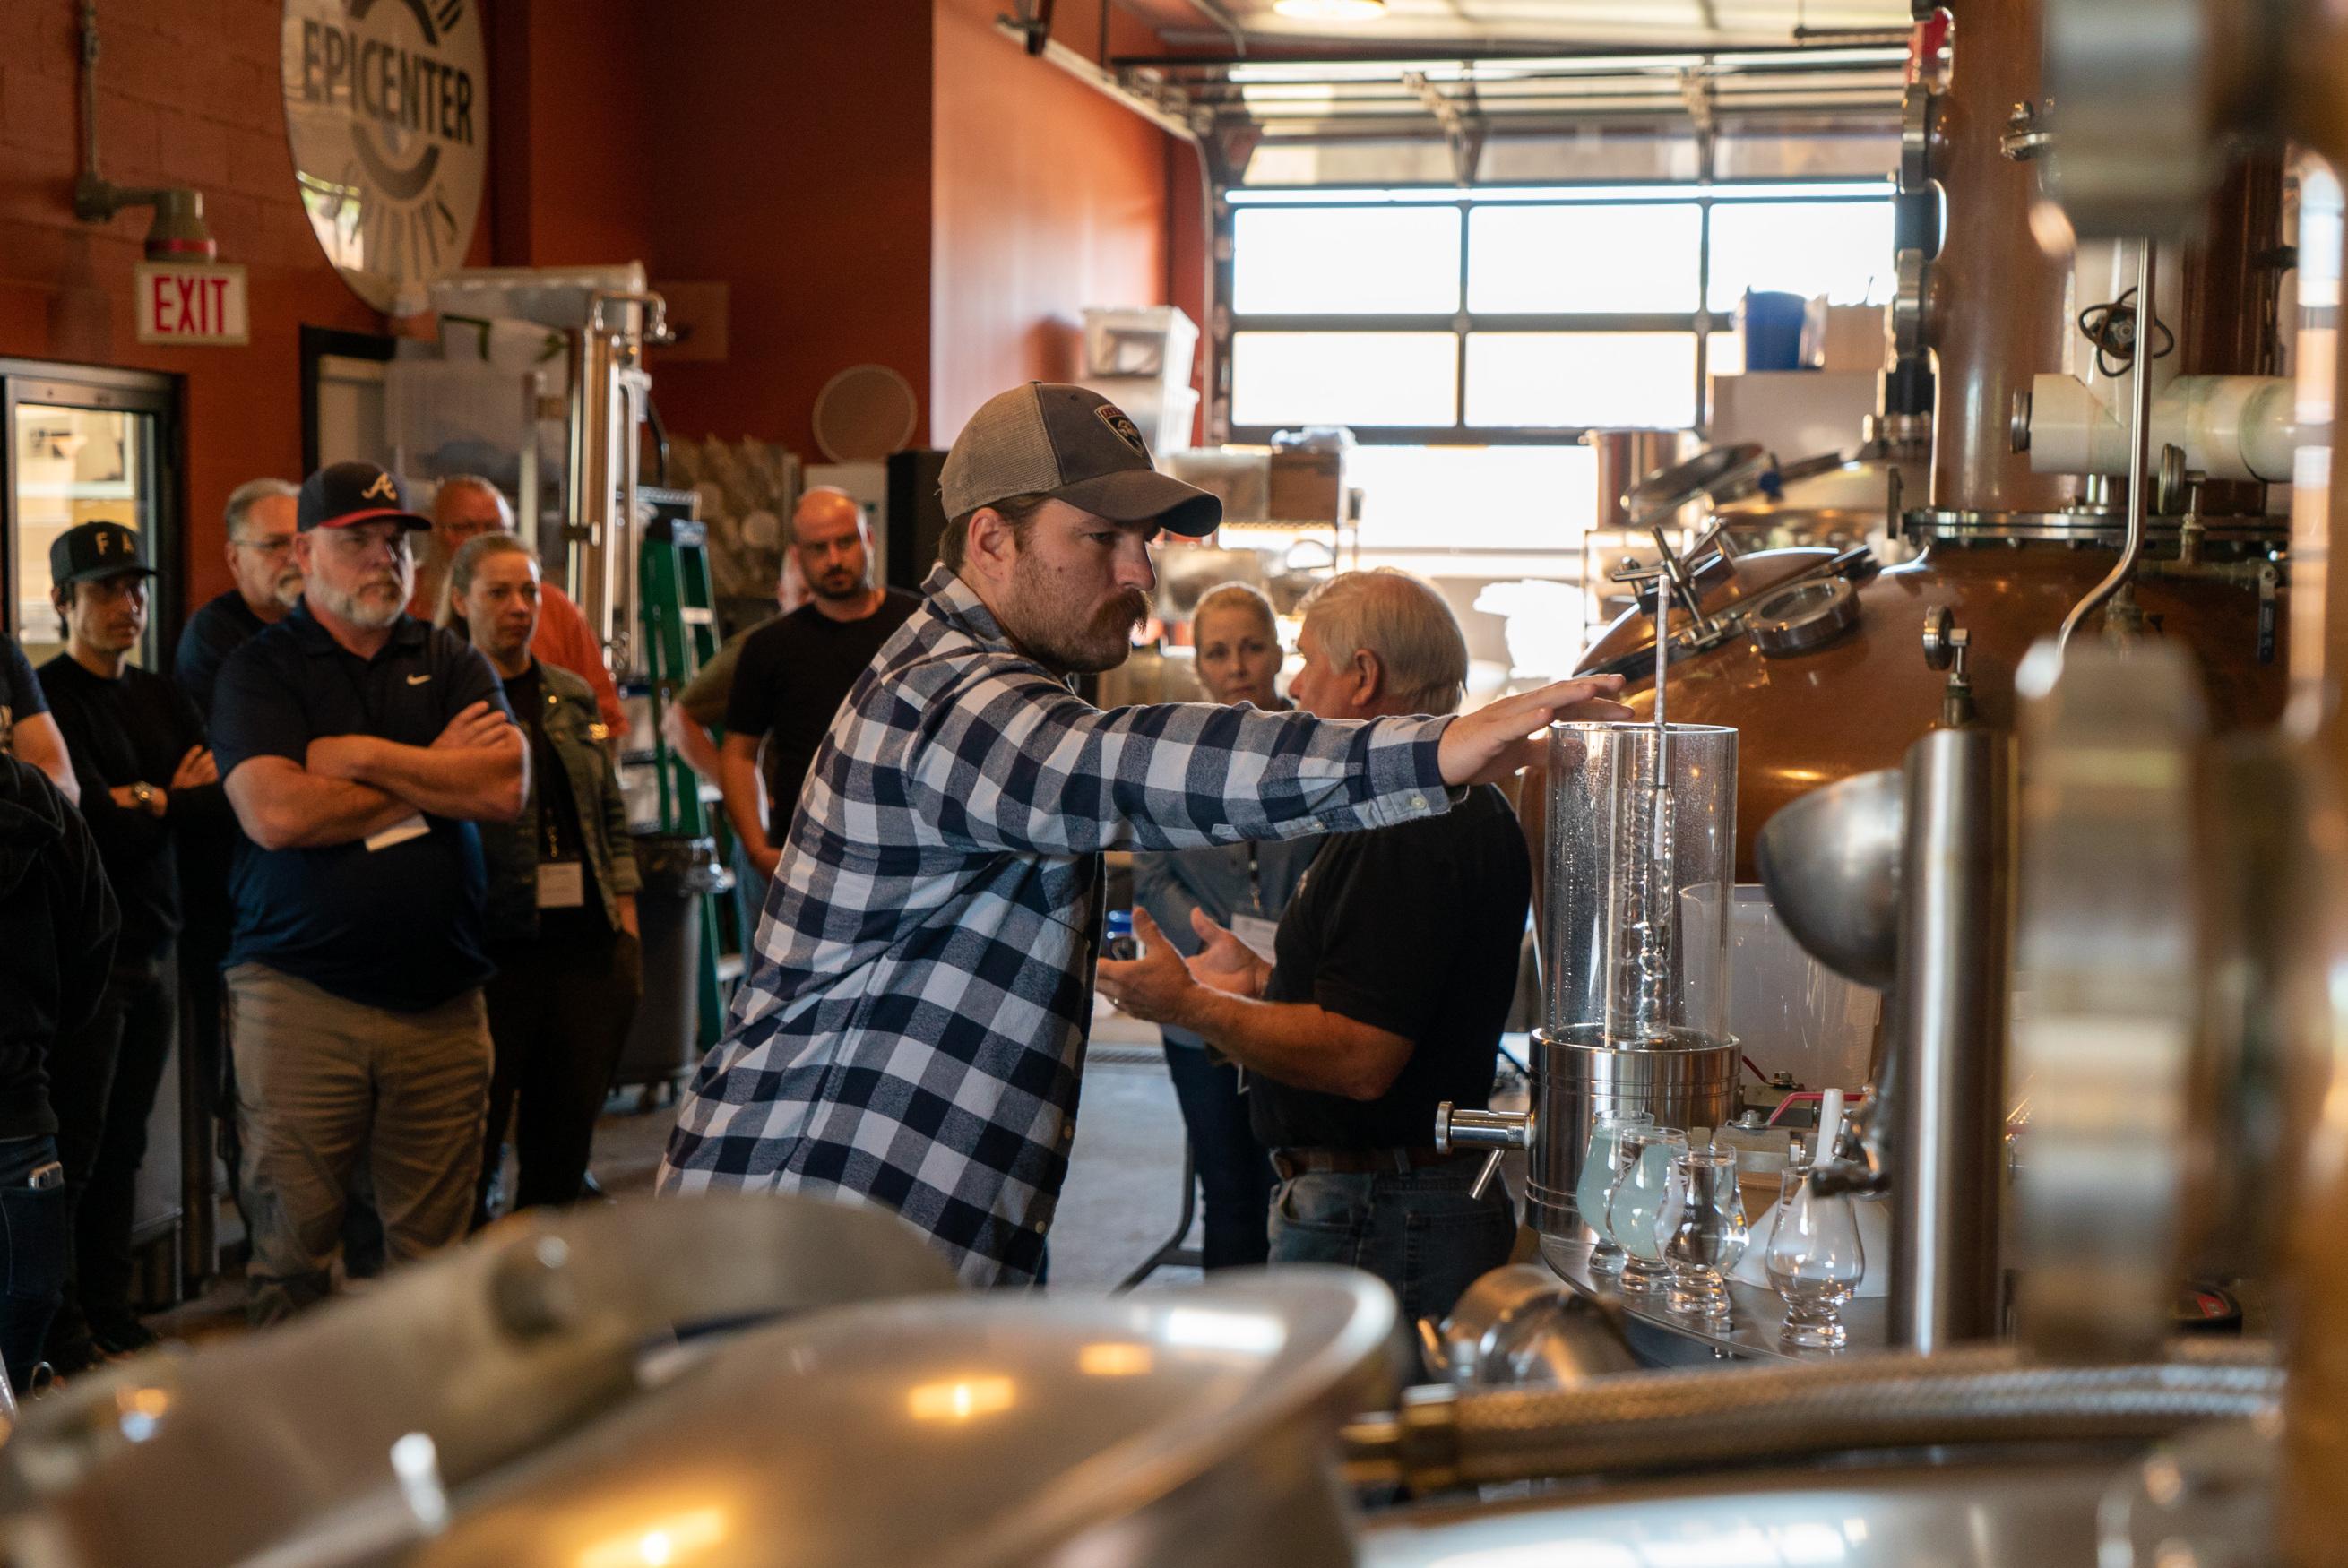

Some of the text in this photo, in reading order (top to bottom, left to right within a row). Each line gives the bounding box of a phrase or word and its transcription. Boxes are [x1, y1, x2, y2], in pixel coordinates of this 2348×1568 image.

[304, 18, 472, 145] EPICENTER
[154, 274, 229, 334] EXIT
[361, 472, 398, 501] A
